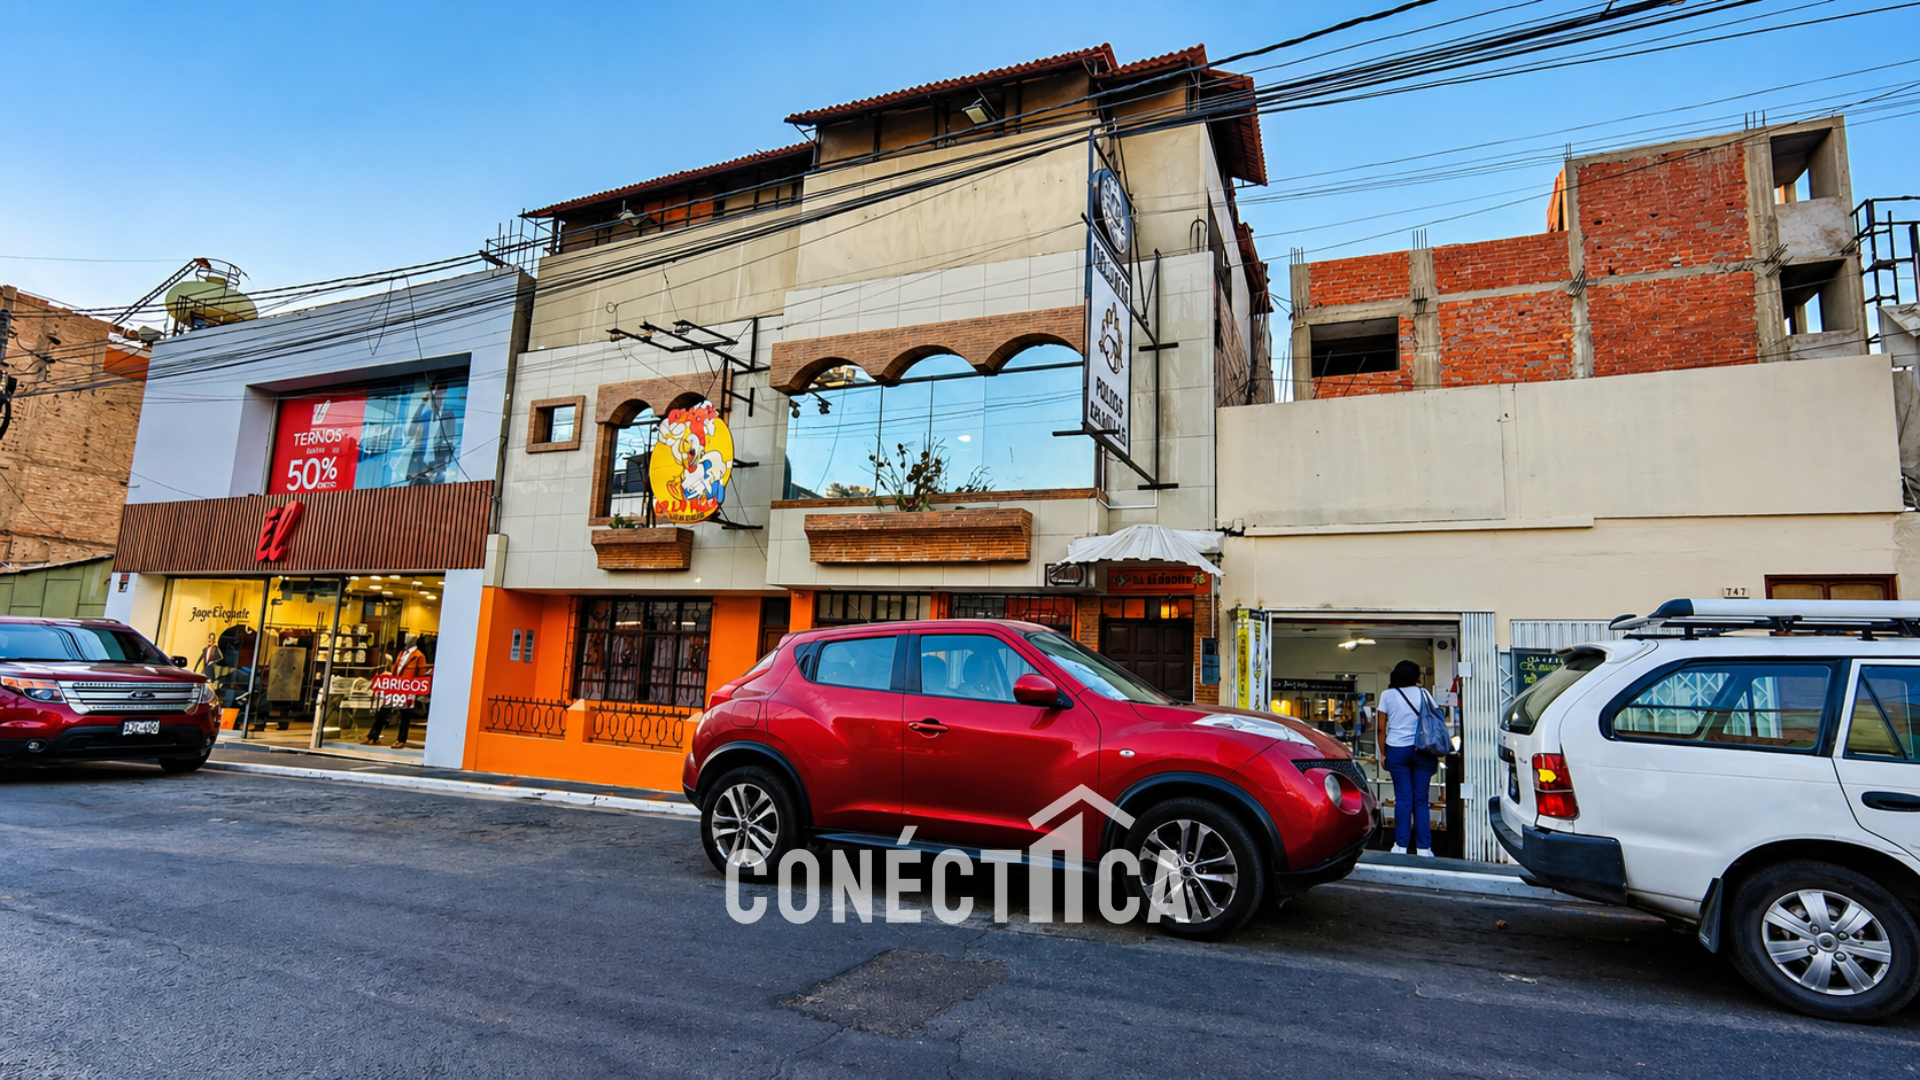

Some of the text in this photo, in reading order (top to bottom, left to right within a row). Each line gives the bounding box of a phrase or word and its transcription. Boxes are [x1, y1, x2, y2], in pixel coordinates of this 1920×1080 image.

[294, 428, 342, 446] TERNOS
[286, 456, 337, 491] 50%
[1726, 587, 1746, 596] 747
[372, 677, 429, 692] ABRIGOS
